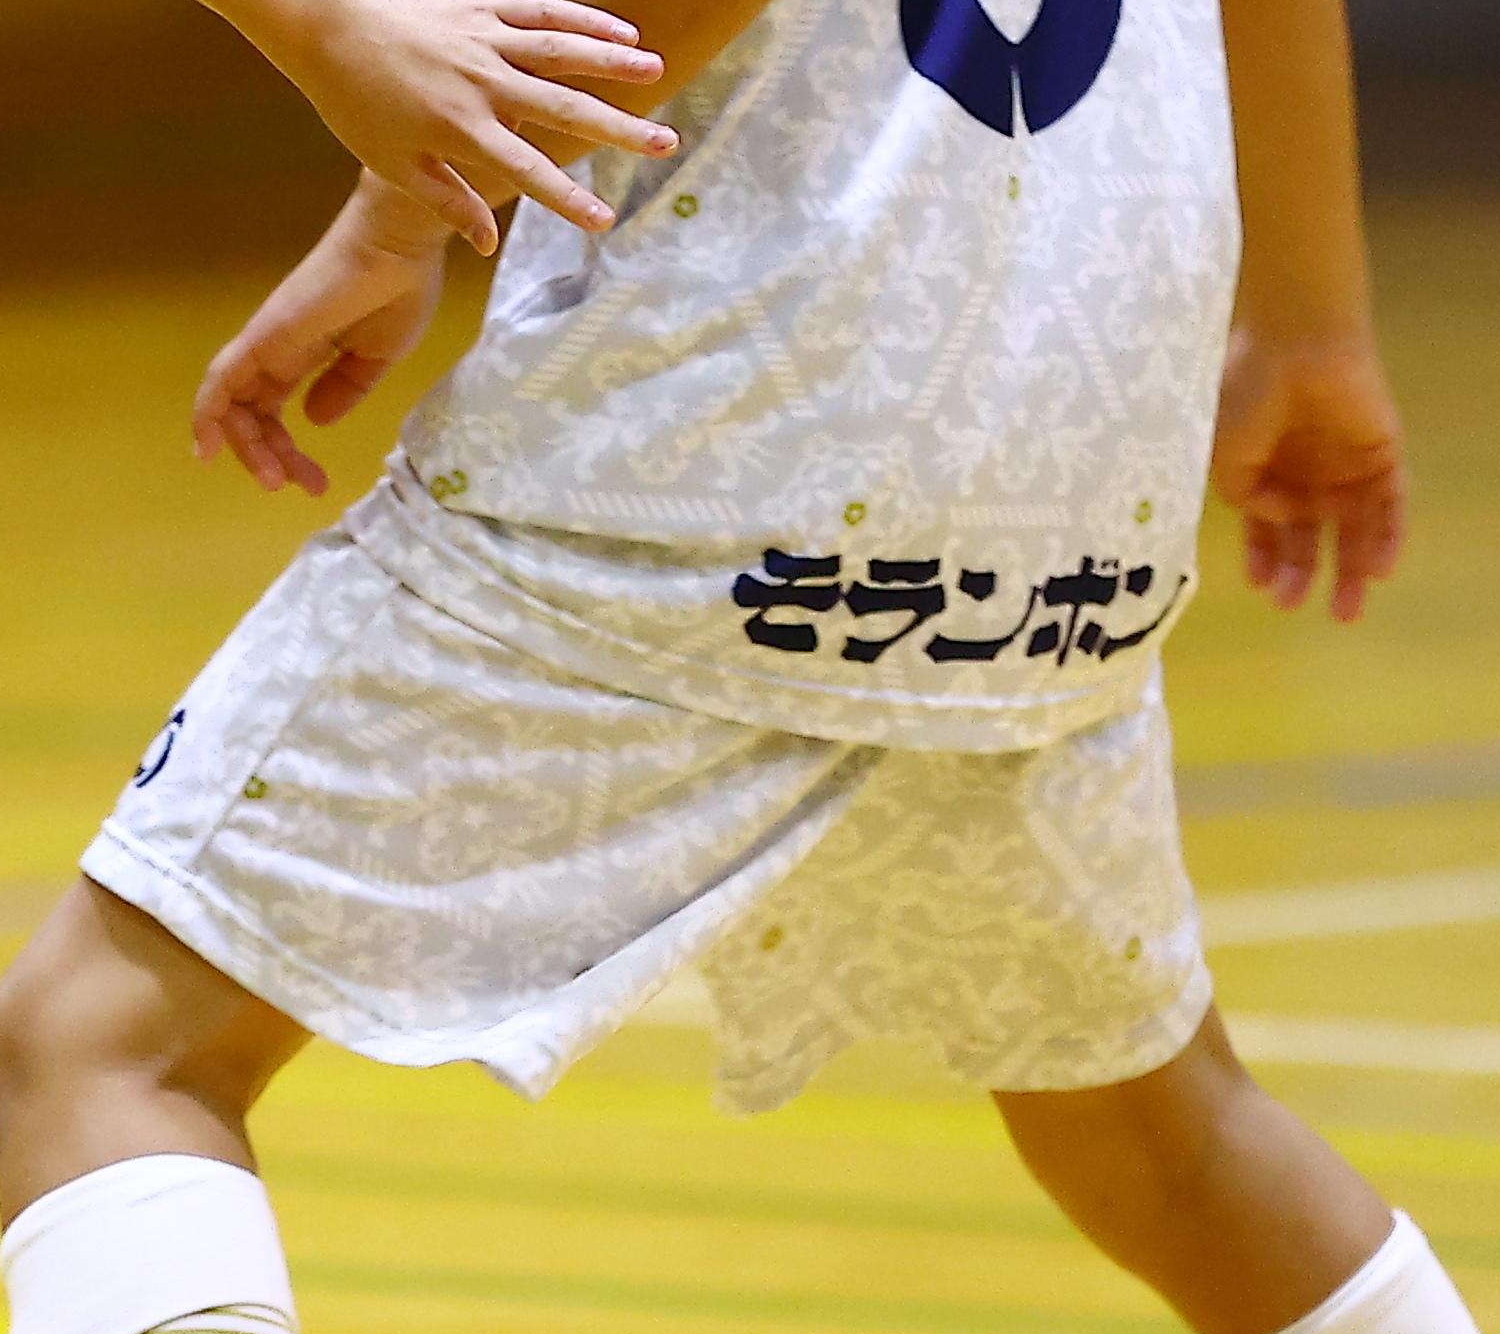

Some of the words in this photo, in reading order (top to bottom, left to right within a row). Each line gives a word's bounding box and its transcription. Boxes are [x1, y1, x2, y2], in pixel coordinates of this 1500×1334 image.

[732, 547, 1188, 666] モランボン
